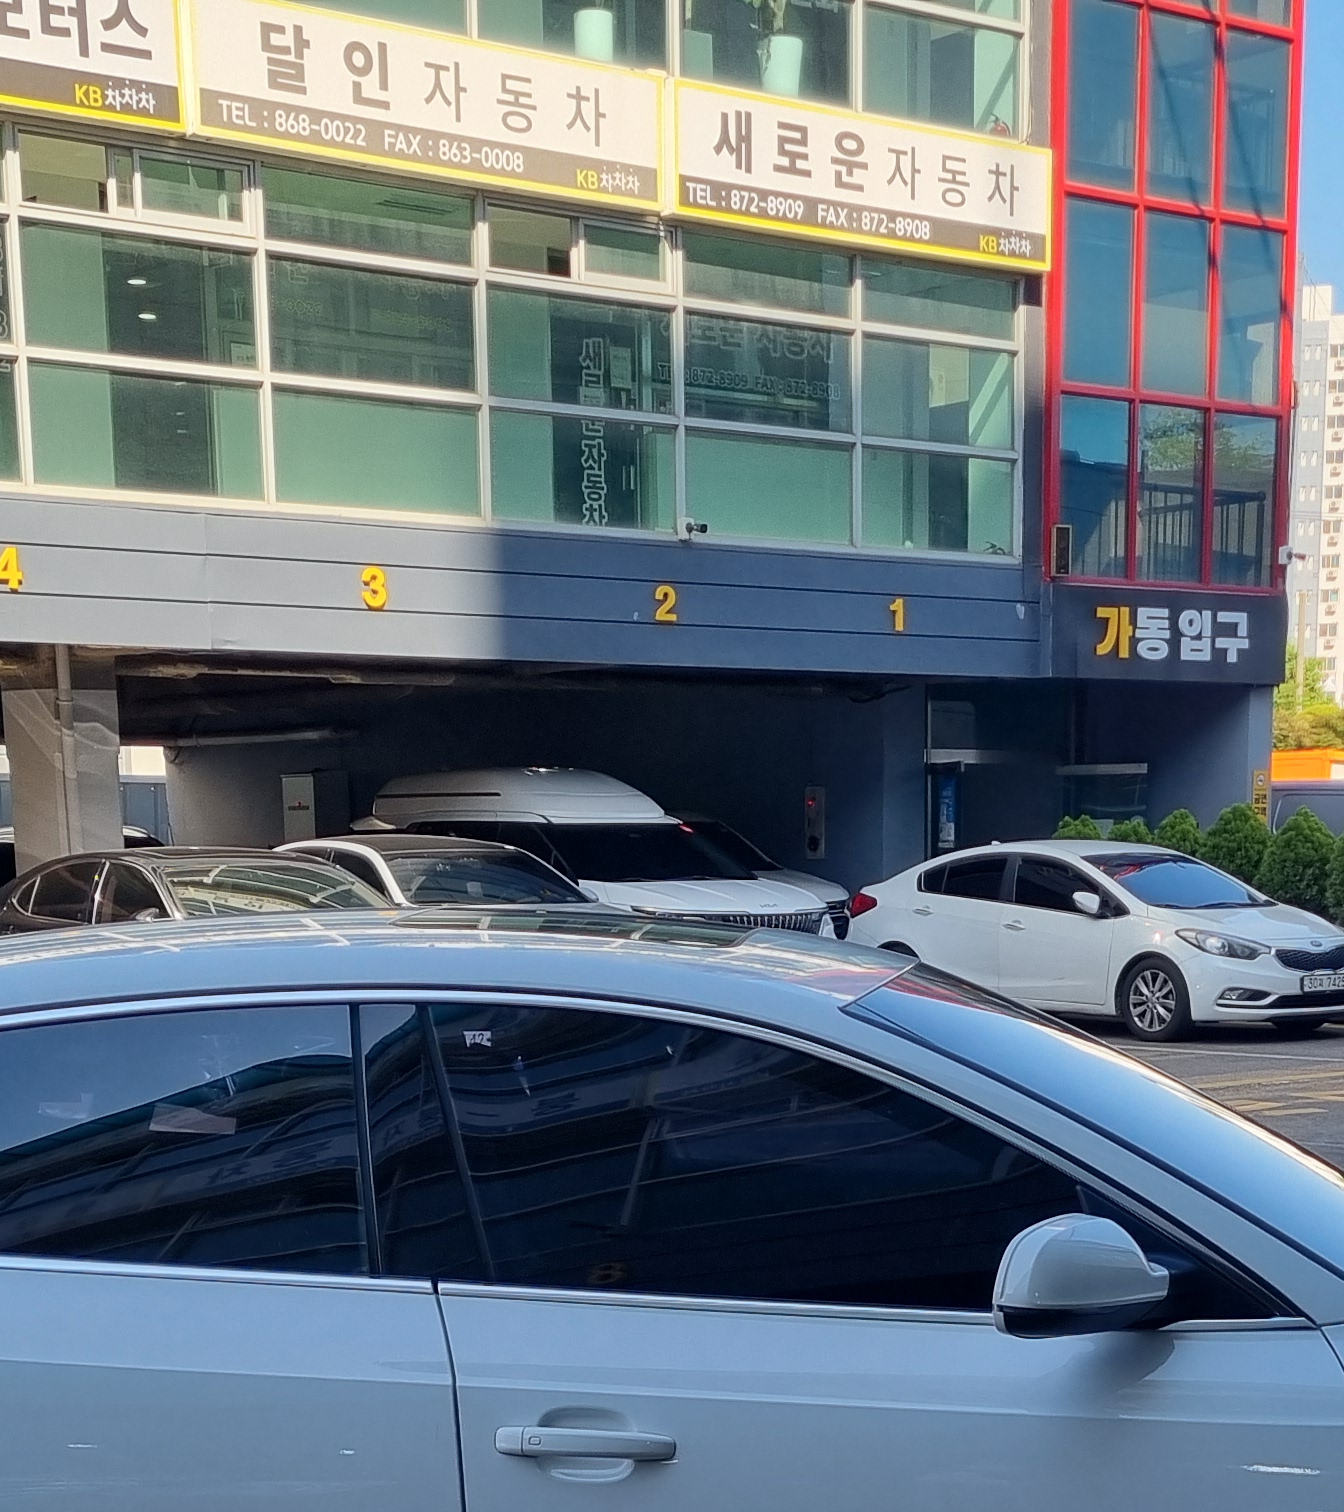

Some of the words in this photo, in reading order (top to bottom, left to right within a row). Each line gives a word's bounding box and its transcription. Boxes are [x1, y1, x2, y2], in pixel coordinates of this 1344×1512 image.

[218, 99, 257, 127] TEL
[275, 109, 367, 147] 868-0022
[384, 130, 422, 157] FAX
[439, 140, 524, 173] 863-0008
[686, 182, 716, 207] TEL
[730, 189, 804, 220] 872-8909
[817, 203, 848, 227] FAX
[861, 211, 931, 240] 872-8908
[363, 565, 387, 611] 3
[655, 585, 677, 622] 2
[889, 599, 904, 631] 1
[1178, 609, 1249, 663] 입구
